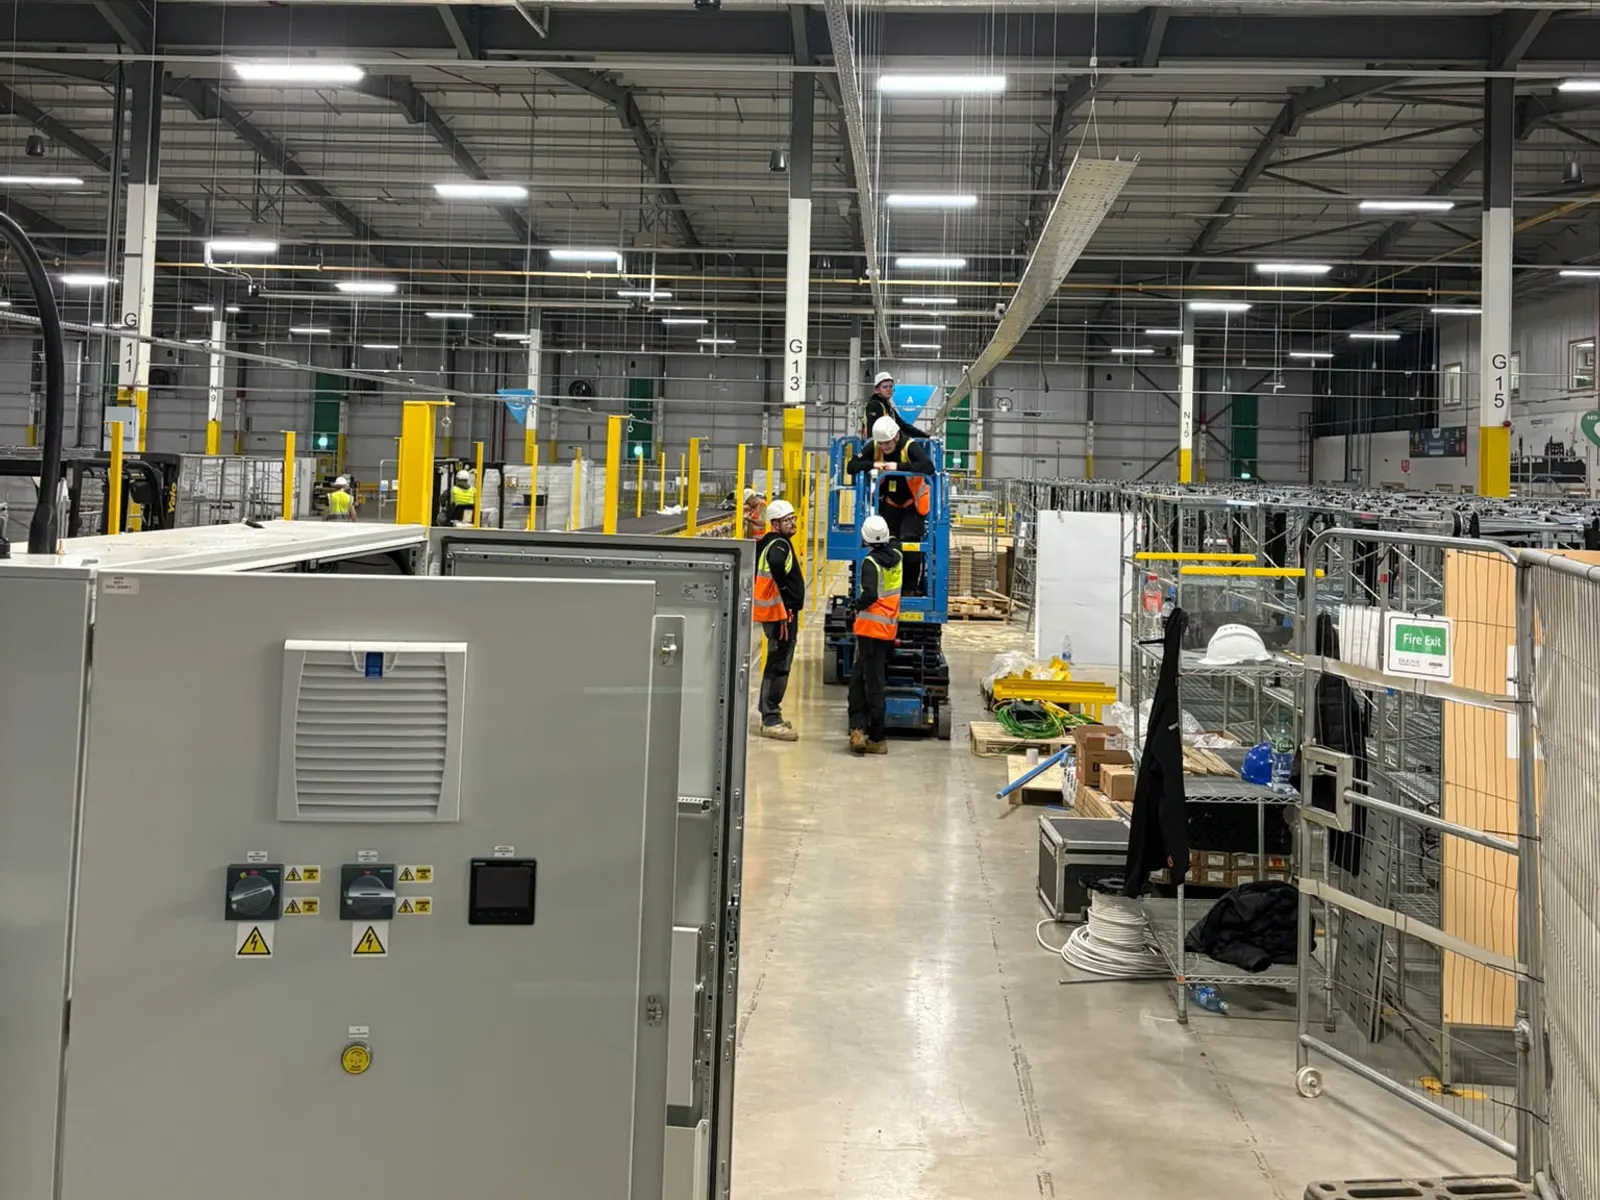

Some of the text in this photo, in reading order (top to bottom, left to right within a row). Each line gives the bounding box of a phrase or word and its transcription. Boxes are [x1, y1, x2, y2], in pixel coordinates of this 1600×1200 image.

[789, 339, 803, 391] G13
[1492, 353, 1507, 409] G15
[1183, 411, 1191, 438] N15
[1403, 632, 1442, 648] Fire Exit
